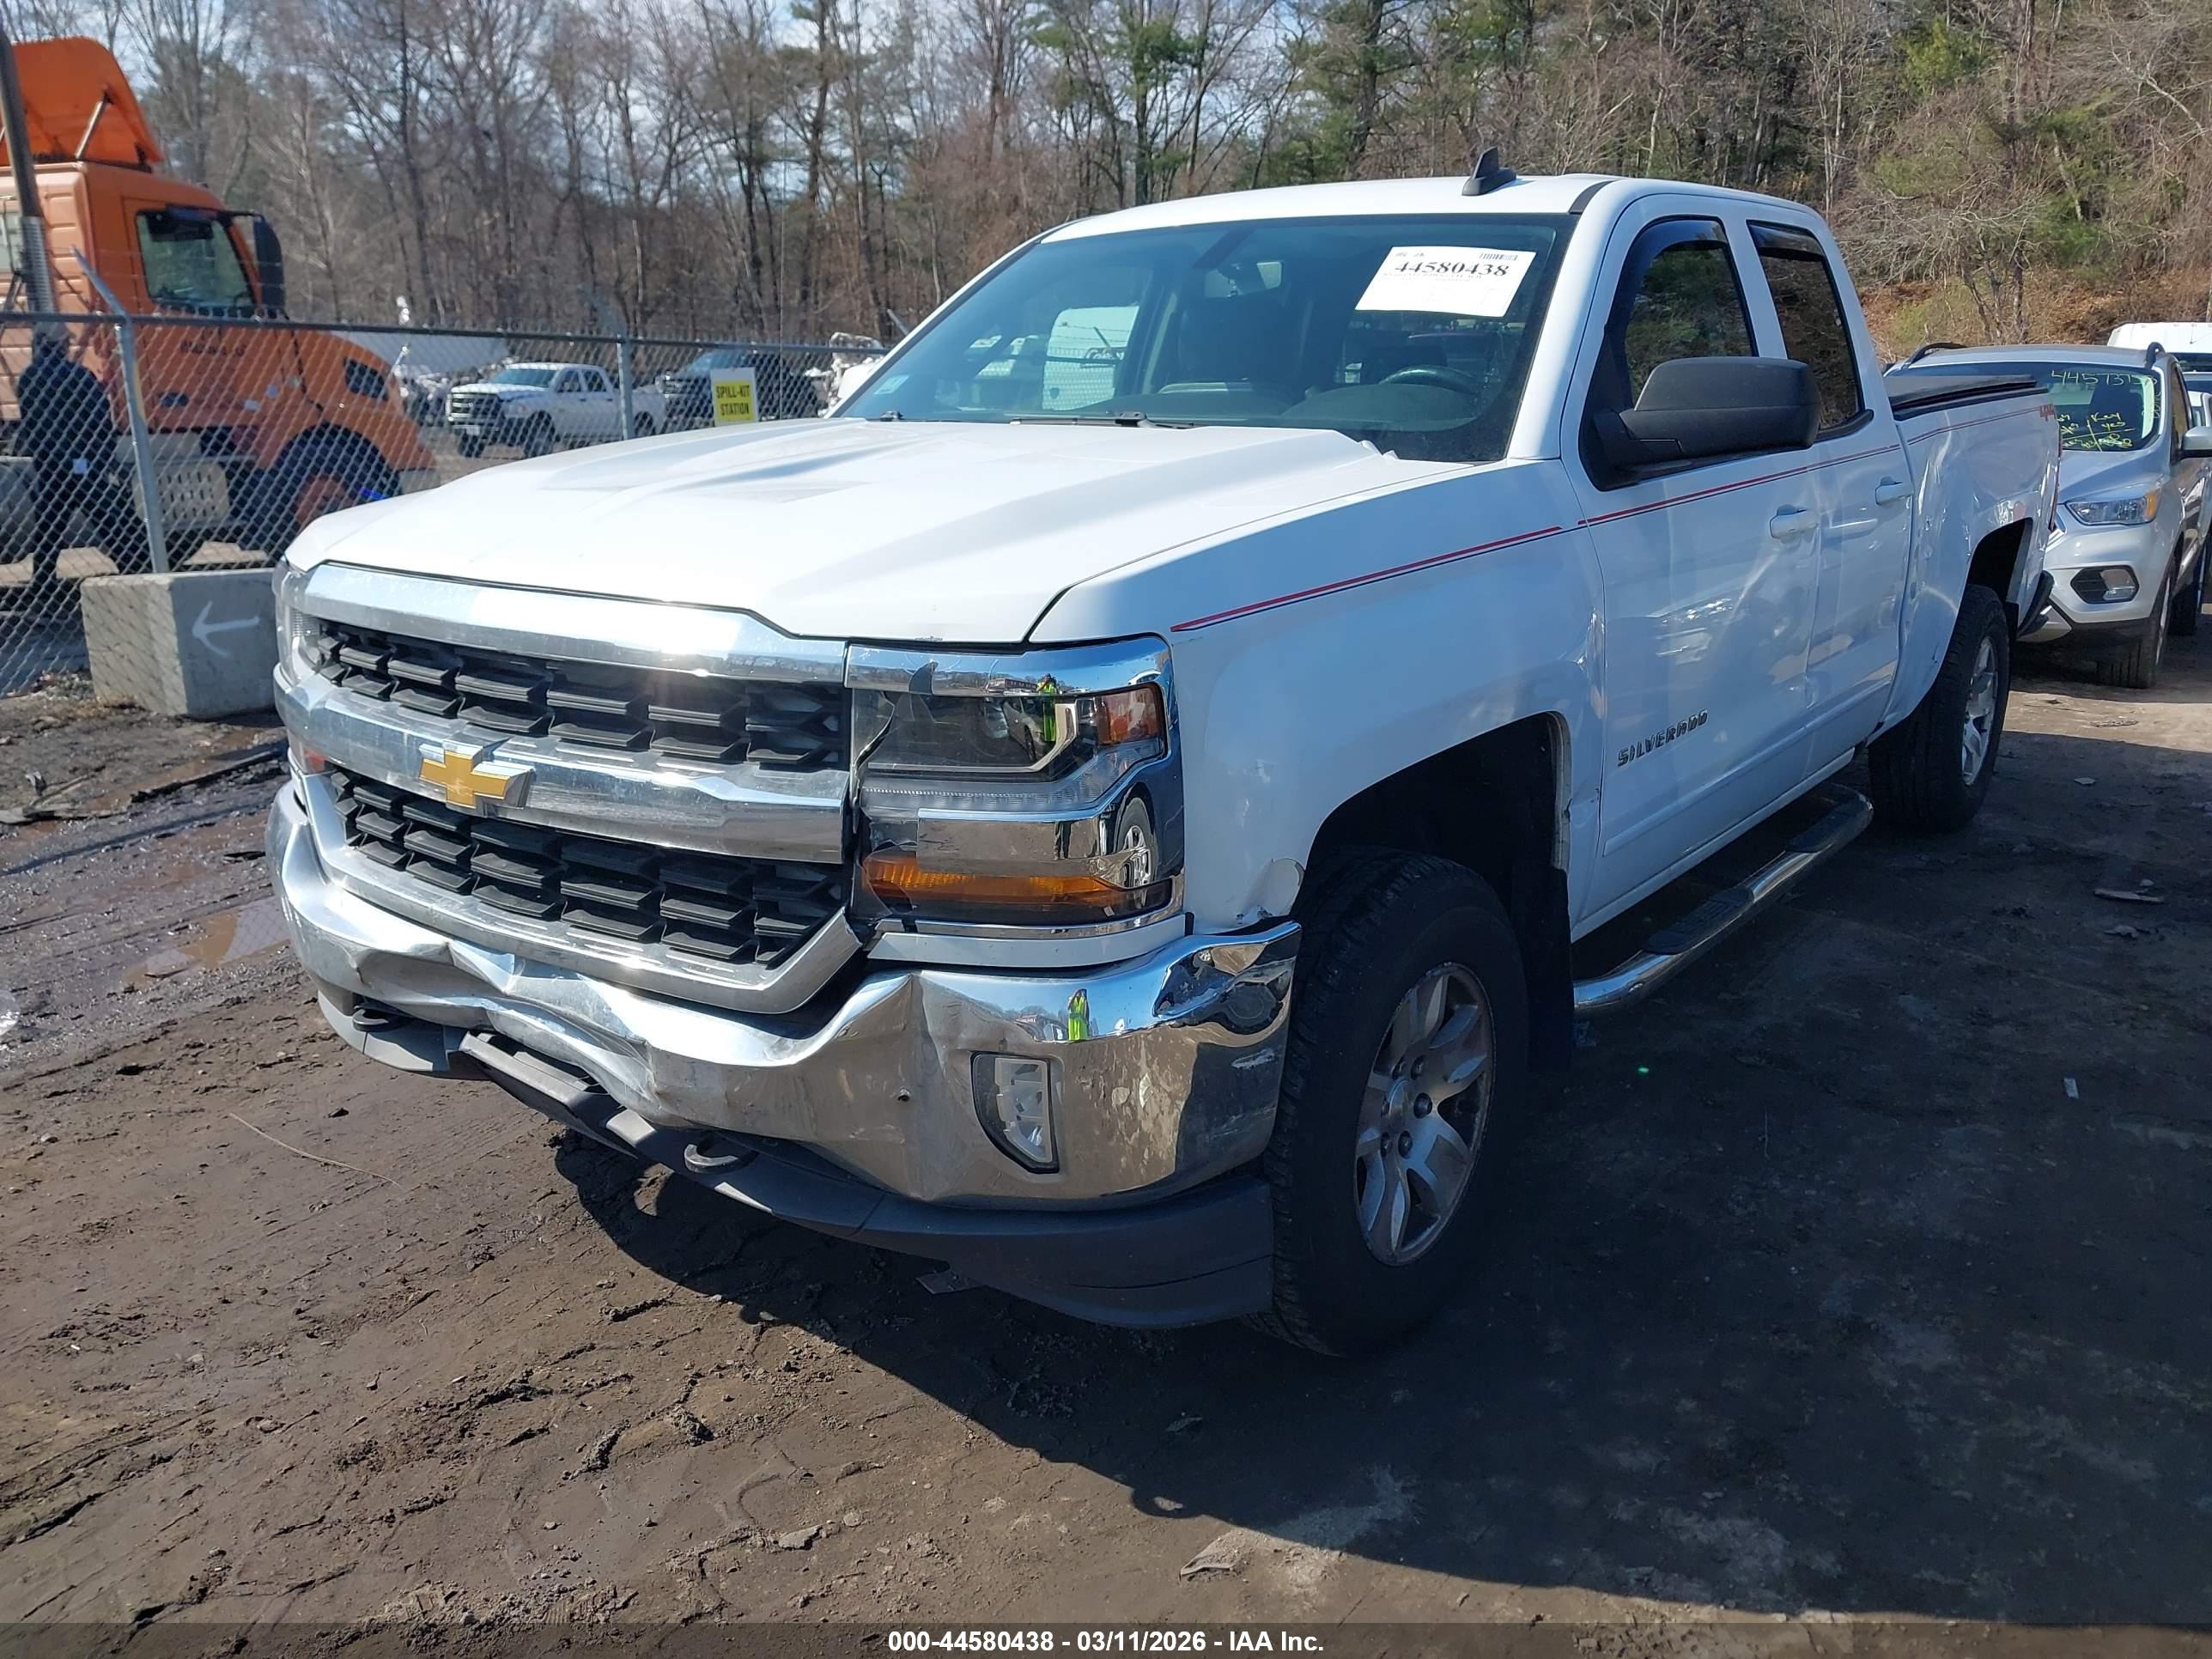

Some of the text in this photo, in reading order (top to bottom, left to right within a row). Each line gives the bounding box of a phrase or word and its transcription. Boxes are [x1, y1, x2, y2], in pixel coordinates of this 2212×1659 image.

[1395, 261, 1510, 276] 44580438
[715, 385, 750, 398] SPILL-KIT
[720, 403, 750, 416] STATION
[1618, 708, 1709, 768] SILVERADO
